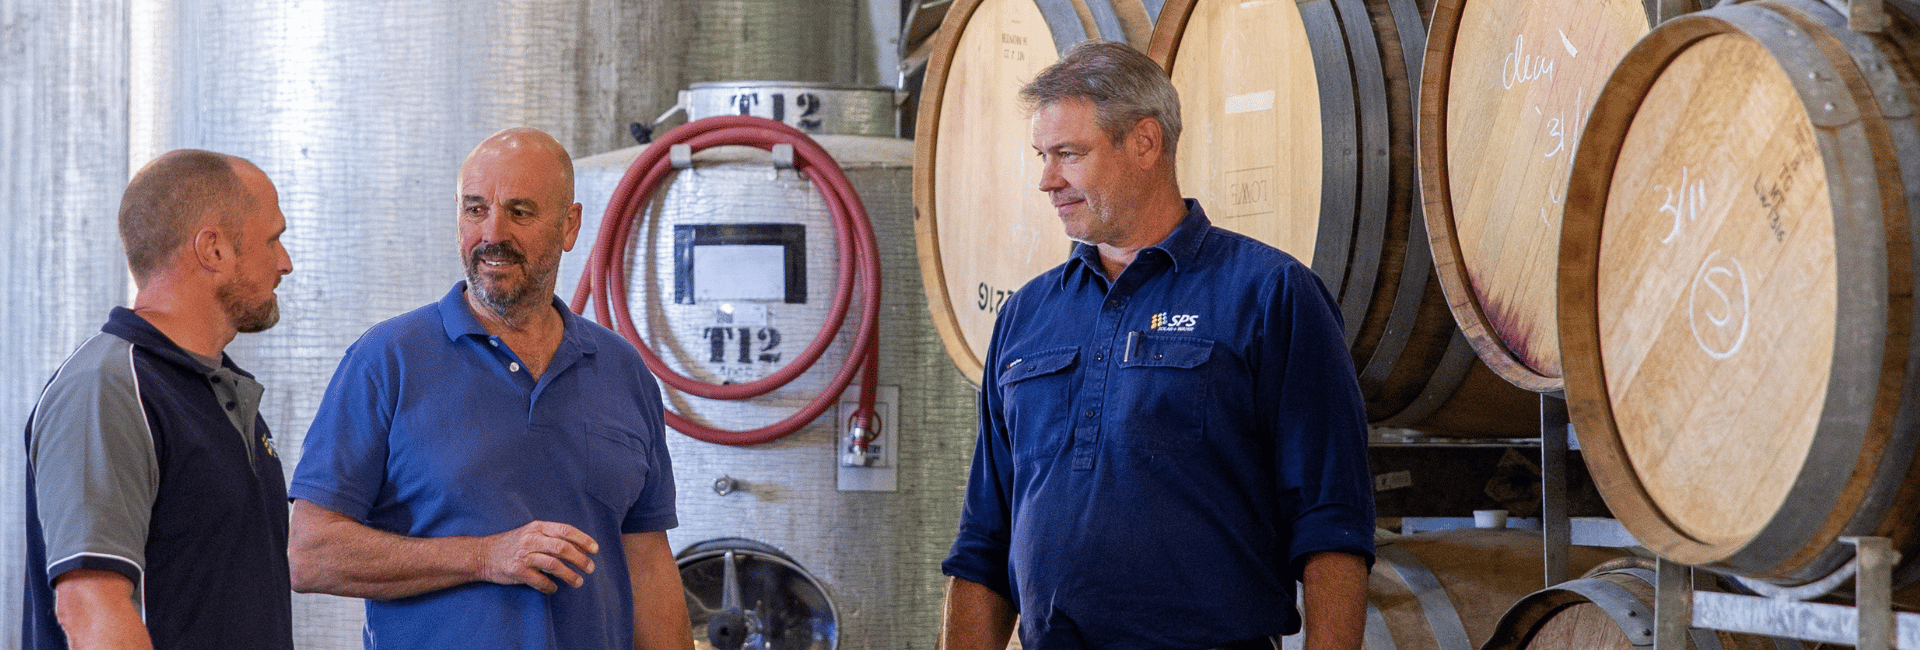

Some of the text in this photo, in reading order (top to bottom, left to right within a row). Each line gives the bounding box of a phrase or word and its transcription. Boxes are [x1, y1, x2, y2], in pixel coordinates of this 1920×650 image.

[730, 92, 822, 131] T12
[978, 282, 1014, 317] 21G
[1168, 314, 1199, 327] SPS
[703, 327, 781, 363] T12
